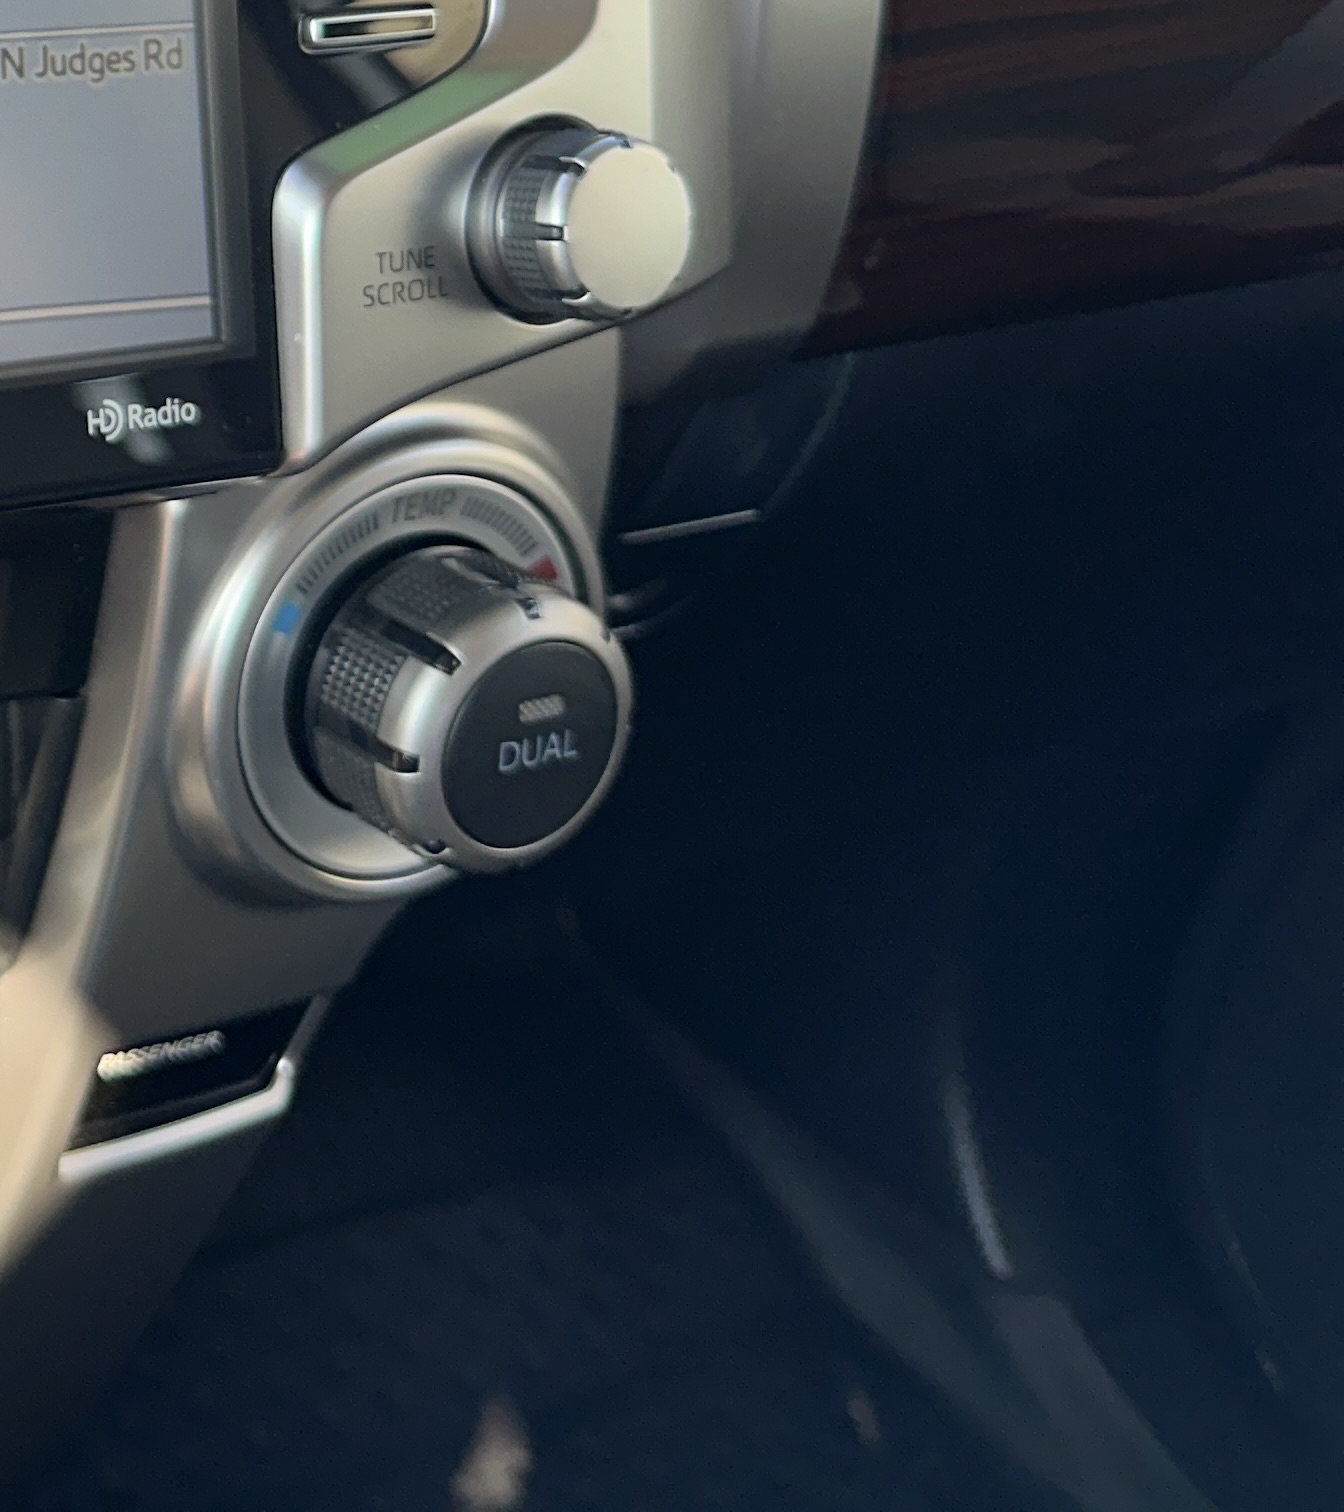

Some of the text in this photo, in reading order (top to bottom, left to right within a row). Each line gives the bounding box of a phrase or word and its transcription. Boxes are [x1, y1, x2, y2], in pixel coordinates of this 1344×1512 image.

[1, 38, 184, 85] N Judges Rd
[375, 246, 435, 274] TUNE
[363, 276, 448, 307] SCROLL
[127, 397, 197, 430] Radio
[391, 487, 457, 522] TEMP
[497, 732, 579, 772] DUAL
